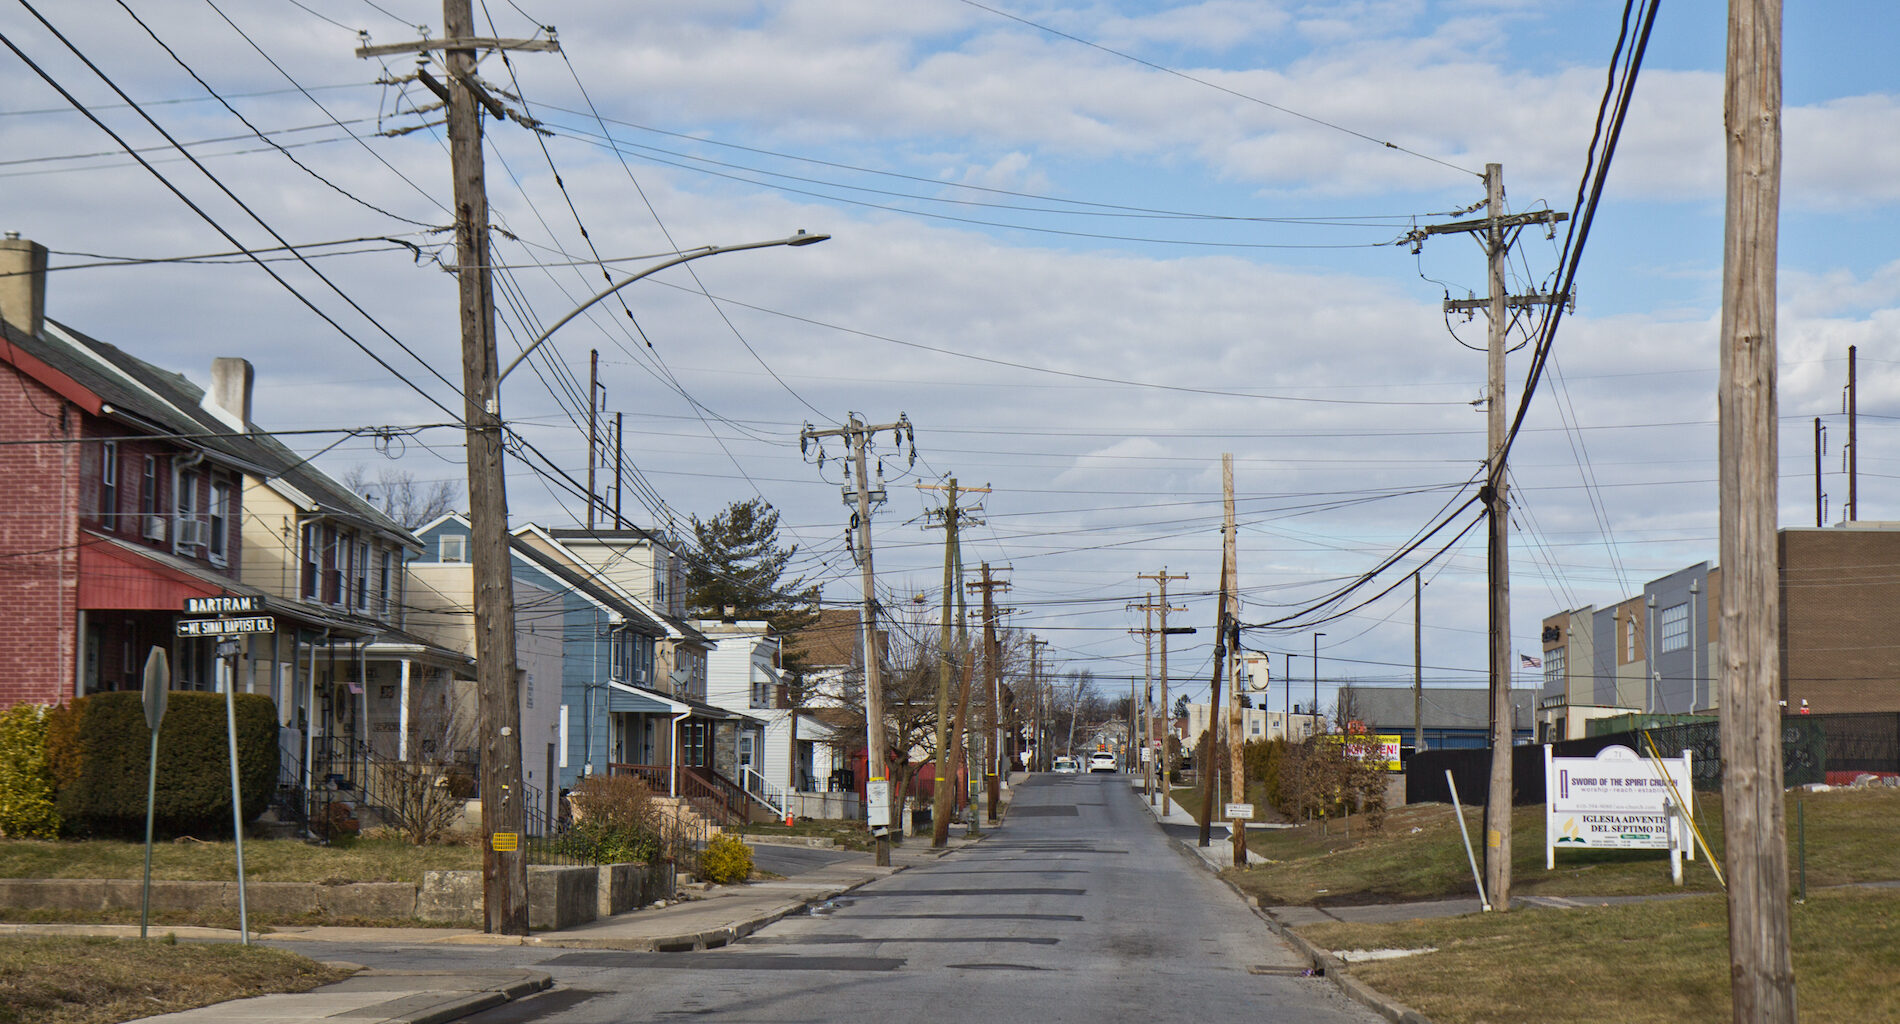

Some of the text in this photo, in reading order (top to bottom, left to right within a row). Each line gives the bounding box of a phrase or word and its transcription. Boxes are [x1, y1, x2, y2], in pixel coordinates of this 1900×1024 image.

[189, 597, 251, 612] BARTRAM
[202, 621, 223, 633] SINAI
[224, 620, 255, 632] BAPTIST
[1572, 778, 1597, 786] SWORD
[1599, 778, 1608, 786] OF
[1610, 778, 1623, 787] THE
[1625, 778, 1647, 787] SPIRIT
[1583, 815, 1620, 823] IGLESIA
[1591, 825, 1610, 833] DEL
